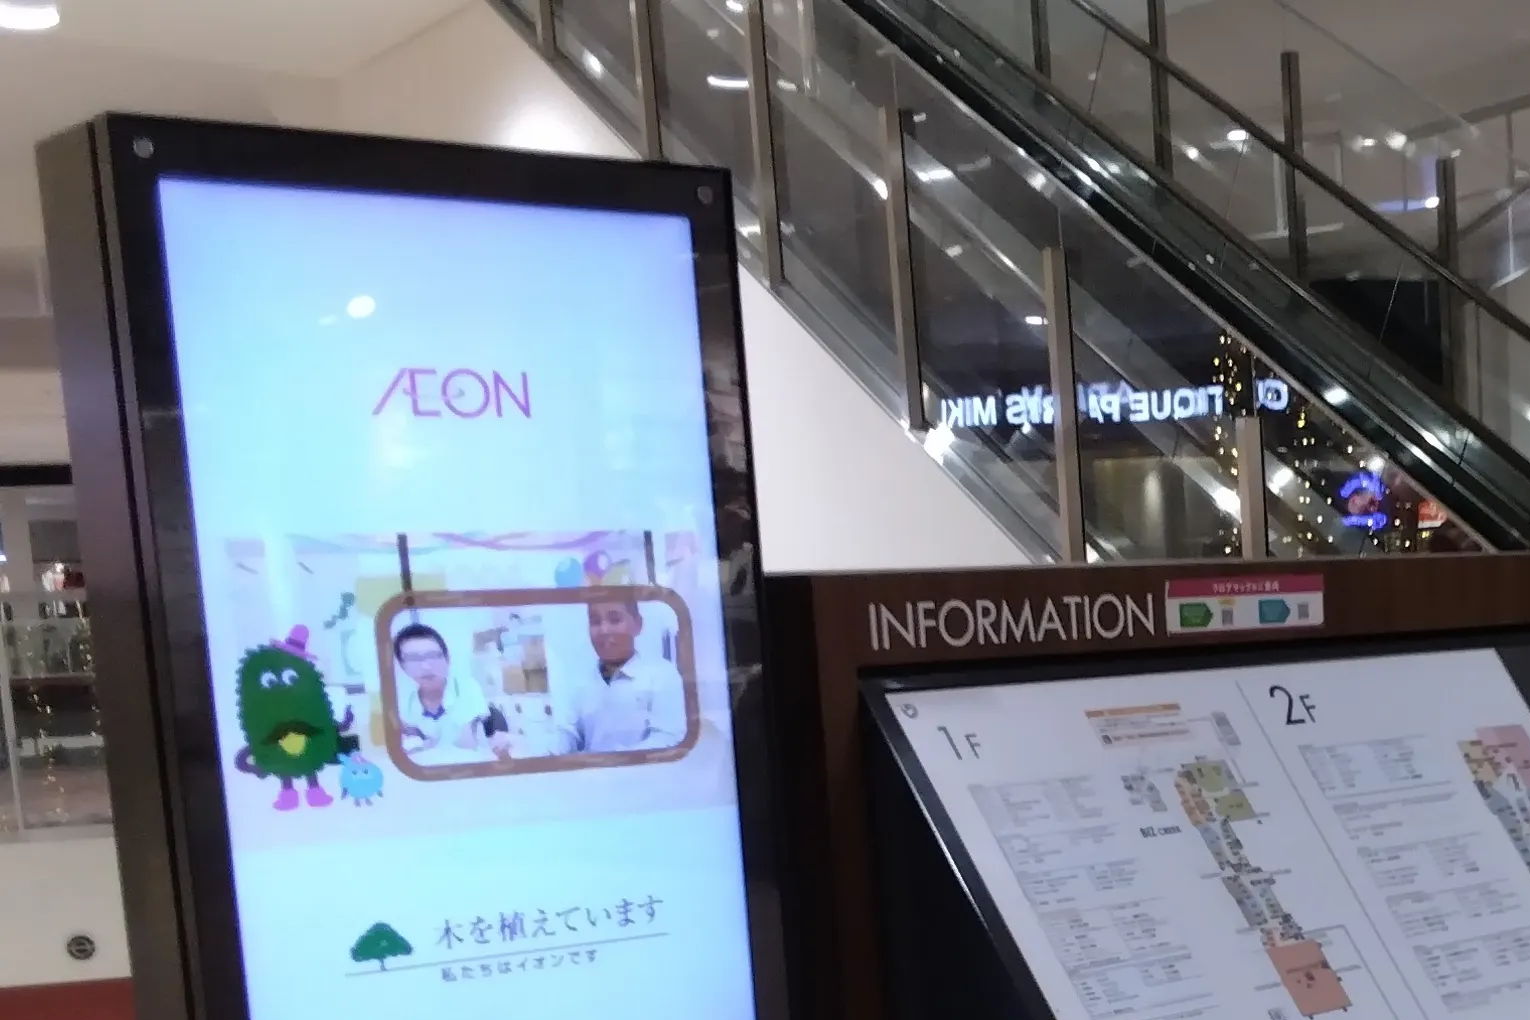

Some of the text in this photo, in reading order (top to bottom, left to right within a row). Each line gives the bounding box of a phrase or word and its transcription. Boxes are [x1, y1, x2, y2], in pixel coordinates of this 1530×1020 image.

[867, 592, 1156, 651] INFORMATION
[1268, 684, 1317, 726] 2F
[937, 724, 982, 761] 1F
[434, 894, 665, 950] 木を植えています
